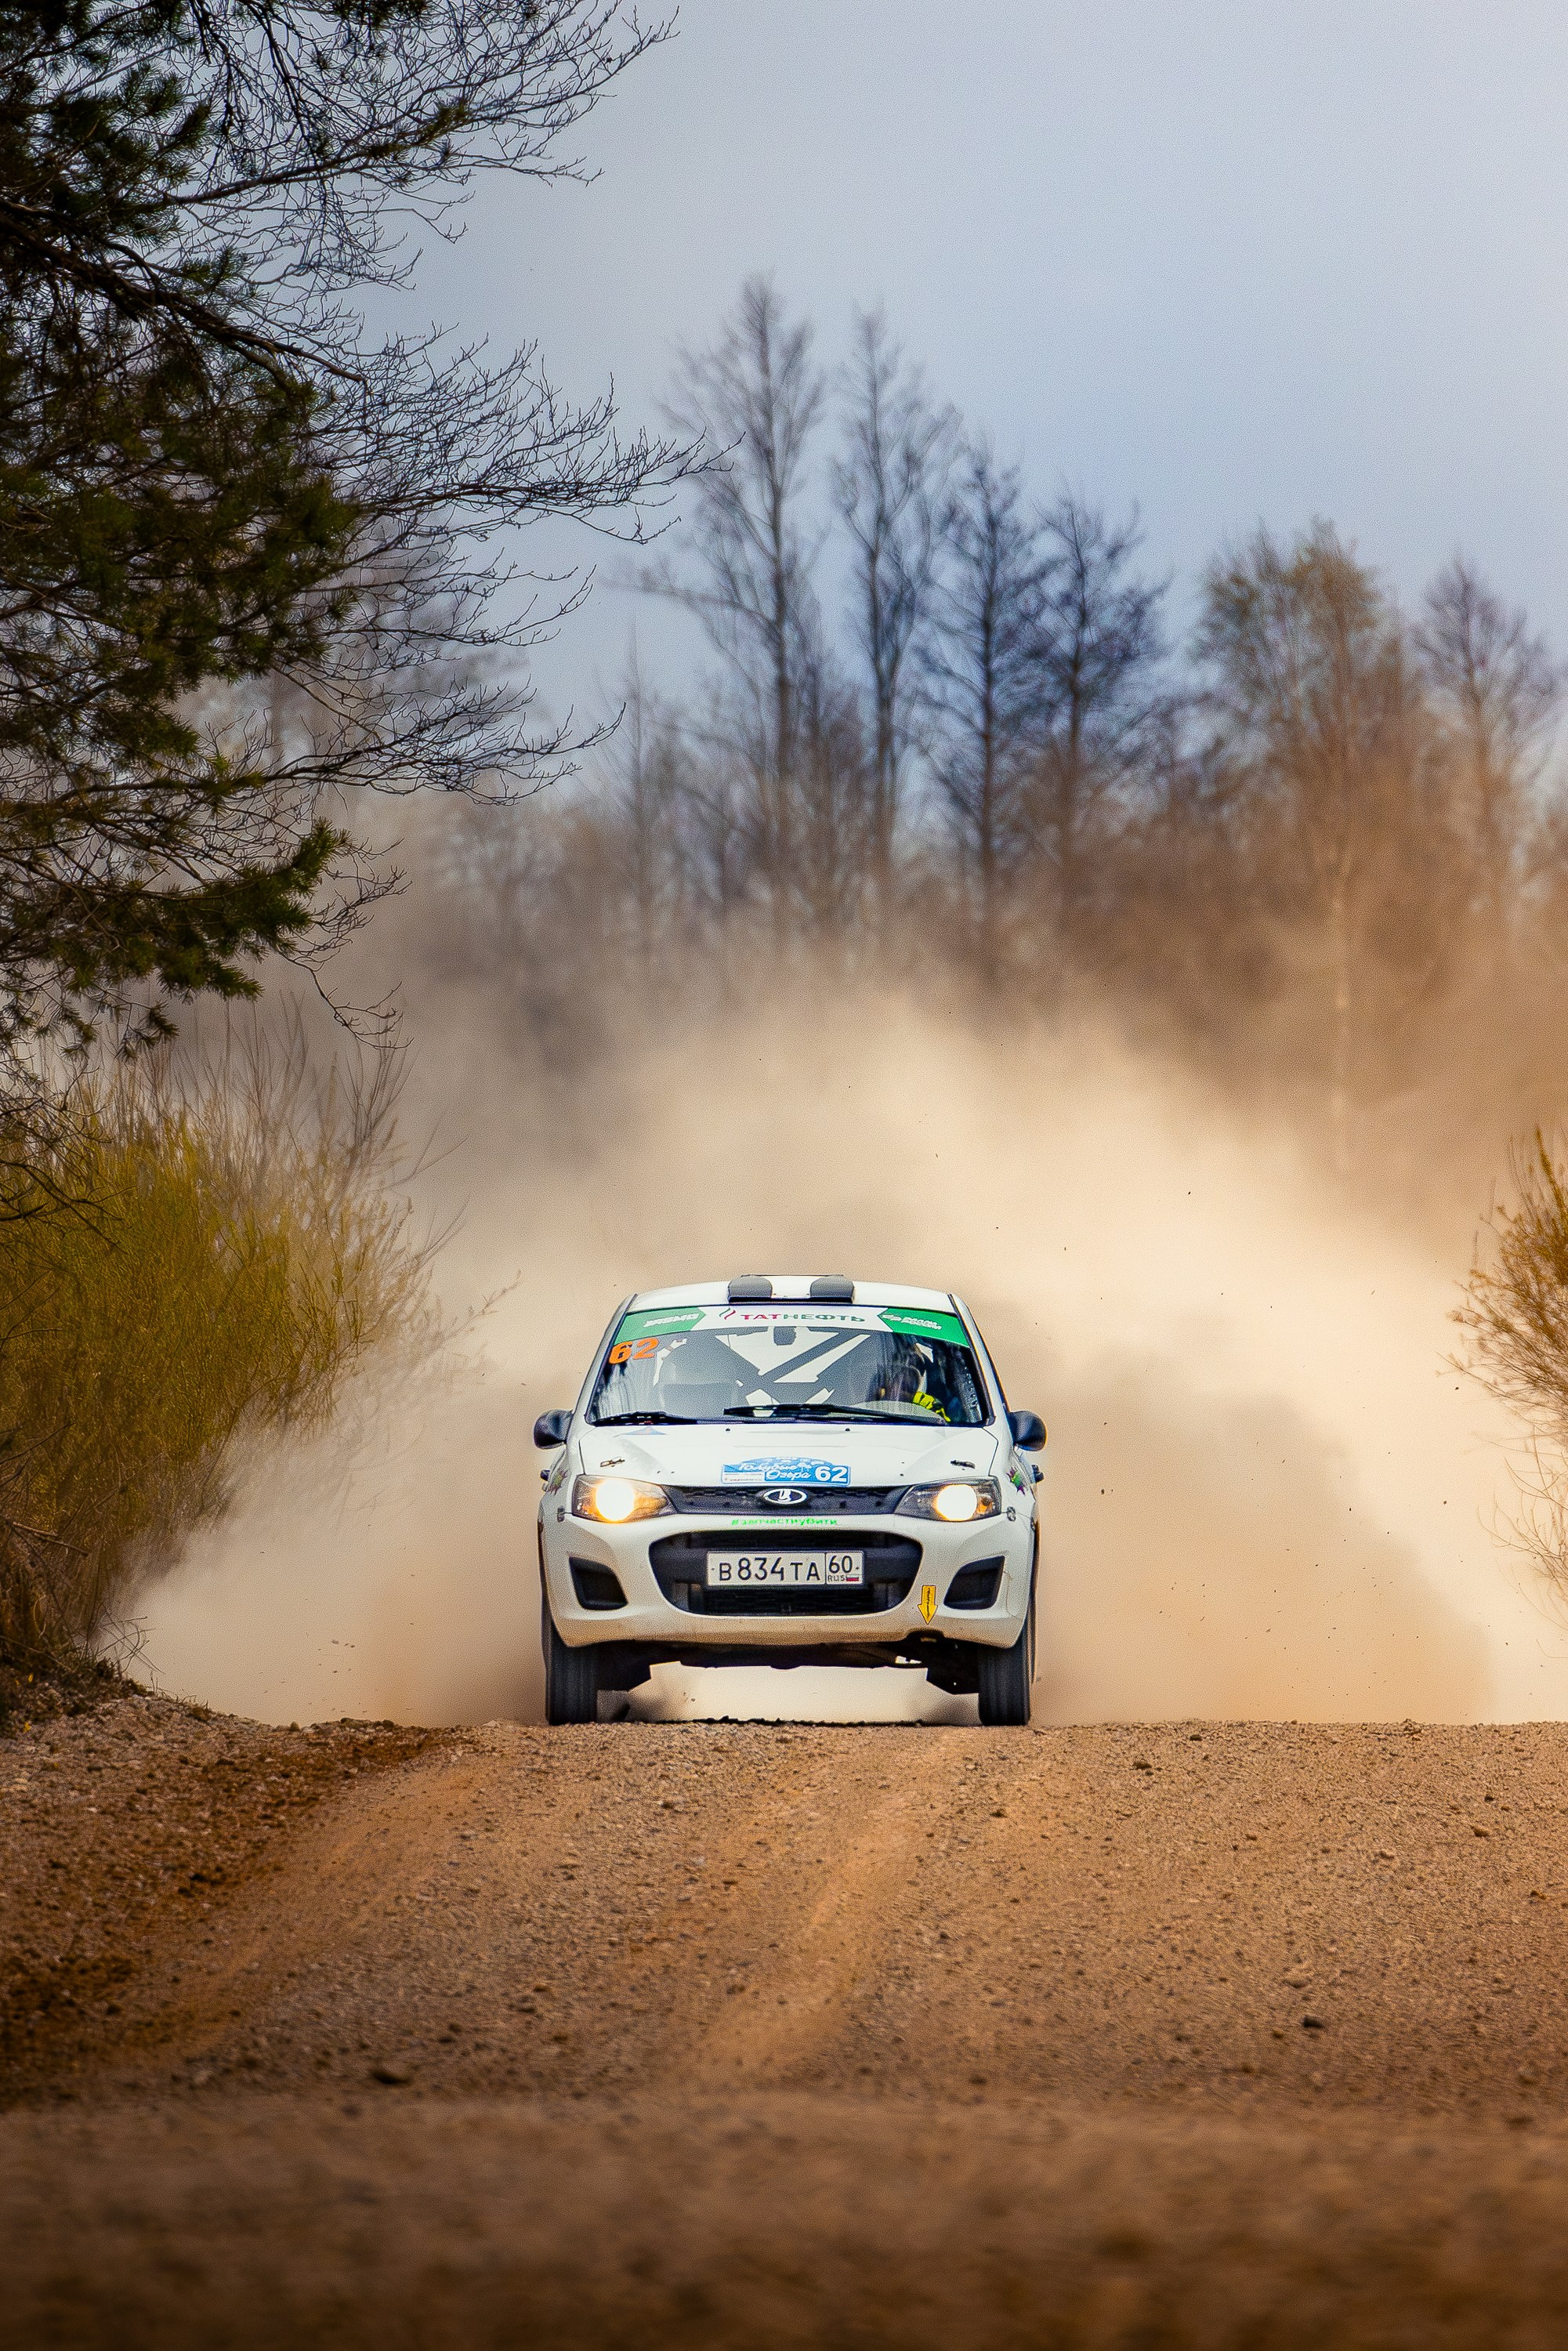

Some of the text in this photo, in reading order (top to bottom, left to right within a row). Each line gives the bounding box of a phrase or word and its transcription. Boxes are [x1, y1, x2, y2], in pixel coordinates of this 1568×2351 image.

[740, 1313, 866, 1322] ТАТНЕФТЬ
[608, 1338, 660, 1365] 62
[814, 1465, 848, 1483] 62
[827, 1555, 853, 1574] 60
